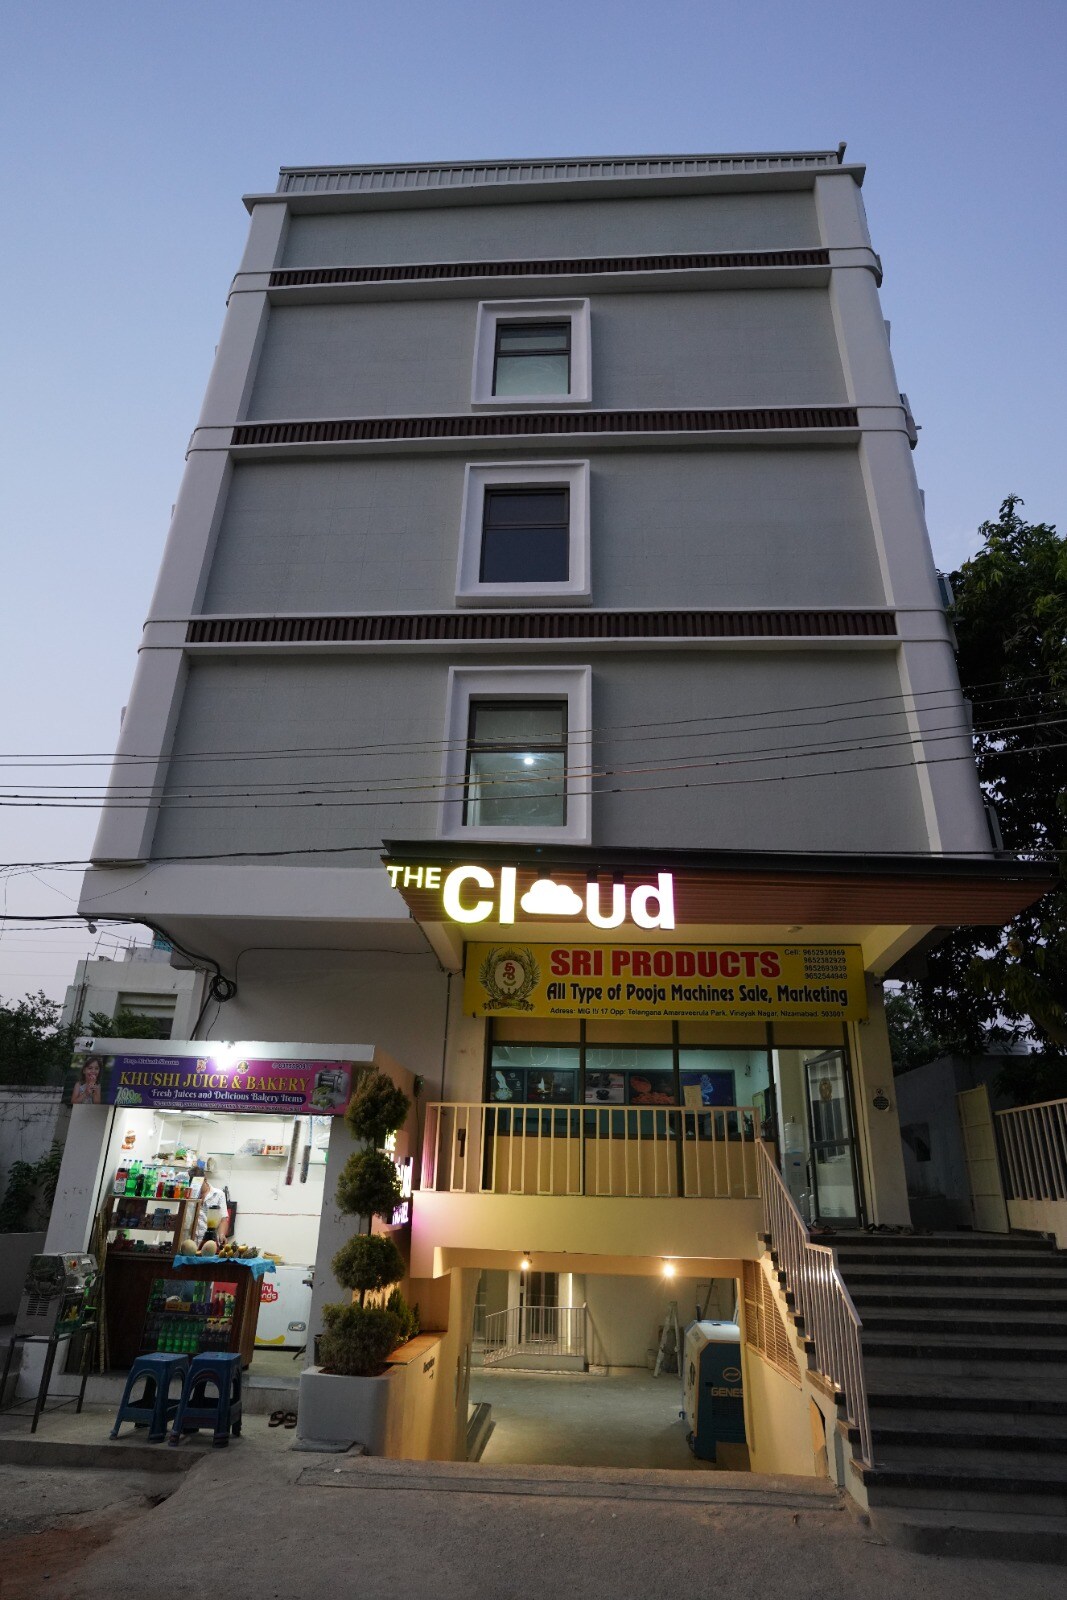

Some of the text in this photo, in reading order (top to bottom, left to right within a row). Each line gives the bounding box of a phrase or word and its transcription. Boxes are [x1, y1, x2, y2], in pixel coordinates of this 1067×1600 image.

[386, 865, 442, 889] THE
[550, 949, 781, 978] SRI PRODUCTS
[547, 982, 848, 1006] All Type of Pooja Machines Sale, Marketing
[119, 1071, 310, 1093] KHUSHI JUICE & BAKERY
[151, 1088, 303, 1104] Fresh Juices and Delicious Bakery Items
